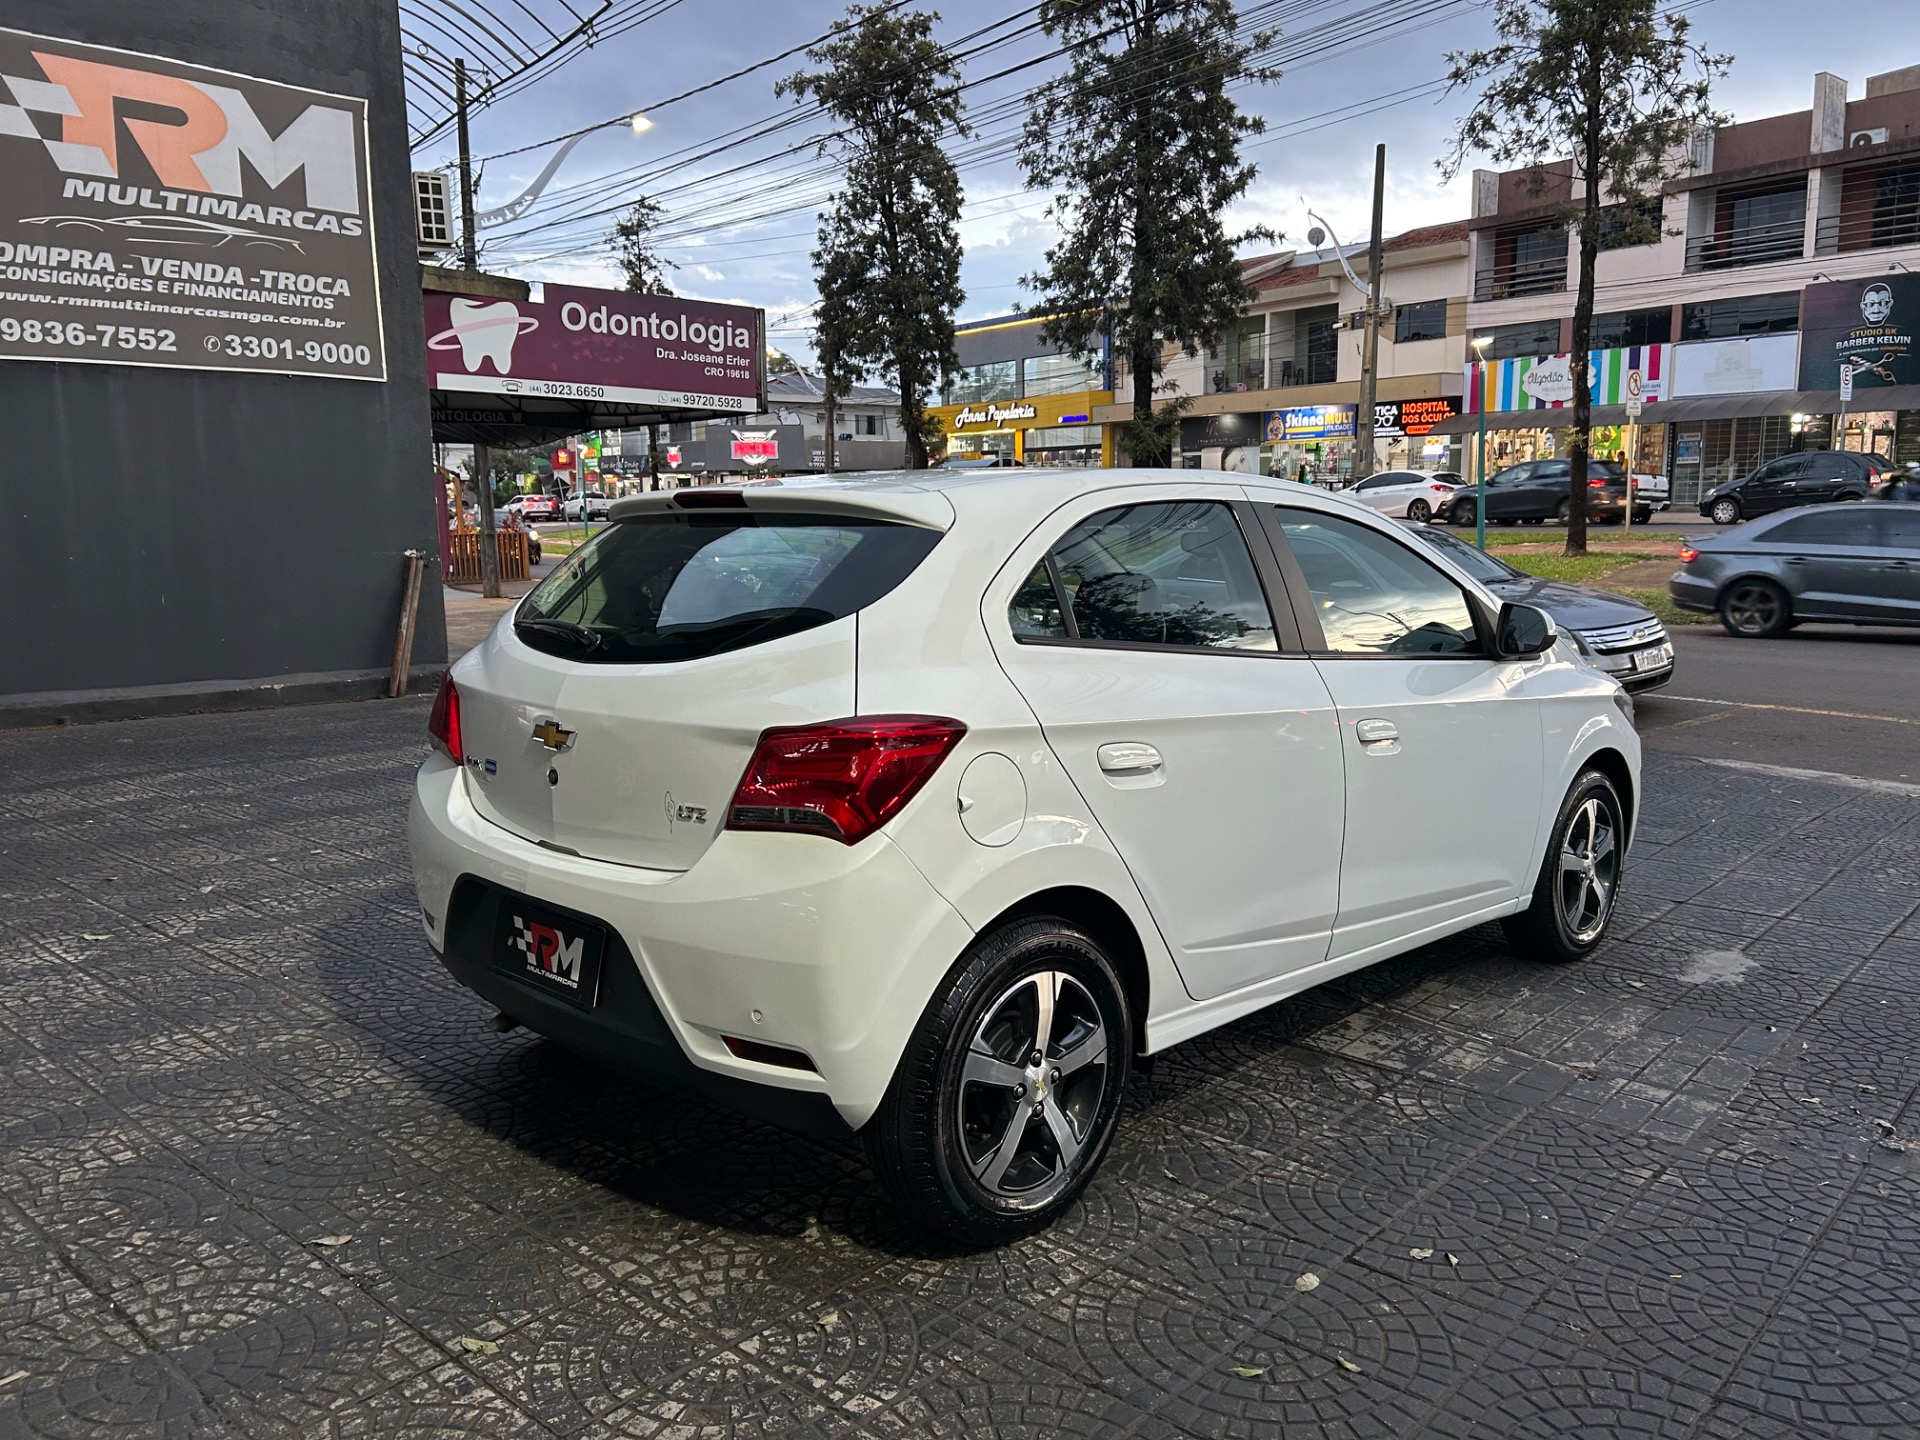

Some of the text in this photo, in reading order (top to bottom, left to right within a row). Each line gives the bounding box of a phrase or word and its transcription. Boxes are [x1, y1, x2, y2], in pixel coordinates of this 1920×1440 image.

[30, 50, 359, 215] RM
[63, 178, 362, 236] MULTIMARCAS
[0, 242, 115, 272] OMPRA
[140, 256, 244, 285] VENDA
[157, 281, 169, 293] E
[173, 281, 334, 309] FINANCIAMENTOS
[0, 291, 345, 329] ww.rmmultimarcasmga.com.br
[561, 302, 750, 353] Odontologia
[1850, 328, 1883, 338] STUDIO
[0, 318, 371, 366] 9836-7552 3301-9000
[1836, 335, 1912, 350] BARBER KELVIN
[656, 347, 750, 367] Dra. Joseane Erler
[704, 367, 750, 379] CRO 19618
[1527, 371, 1564, 386] Algodão
[529, 383, 604, 398] (44) 3023.6650
[670, 394, 742, 409] (44) 99720.5928
[1374, 401, 1450, 416] TICA HOSPITAL
[955, 402, 1035, 428] Anna Papelaria
[1401, 414, 1420, 423] DOS
[1324, 424, 1353, 432] UTILIDADES
[677, 805, 708, 824] LTZ
[529, 921, 584, 982] RM
[526, 964, 578, 989] MULTIMARCAS
